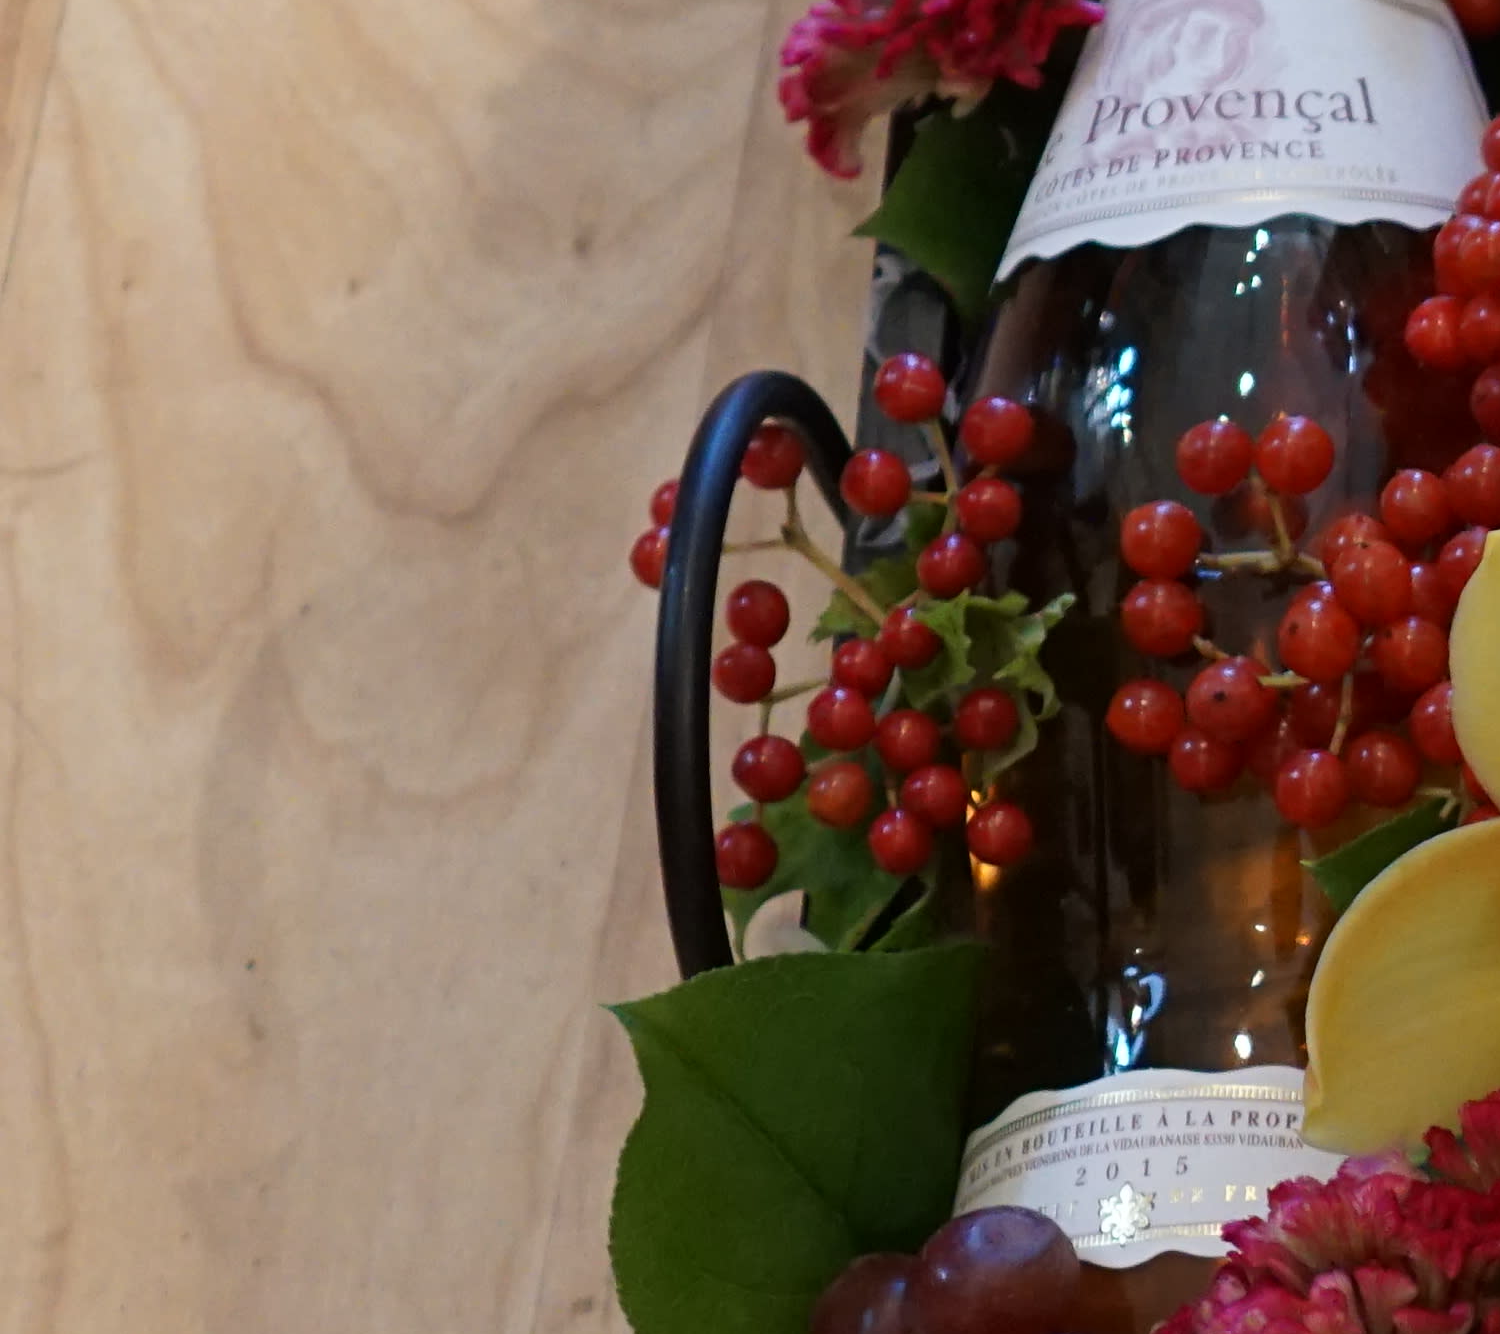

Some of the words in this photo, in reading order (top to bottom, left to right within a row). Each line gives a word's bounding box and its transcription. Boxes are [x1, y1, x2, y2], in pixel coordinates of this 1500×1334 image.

[1083, 77, 1380, 146] Provençal
[1106, 153, 1141, 178] DE
[1153, 140, 1326, 170] PROVENCE
[1021, 1114, 1144, 1155] BOUTEILLE
[1184, 1110, 1215, 1127] LA
